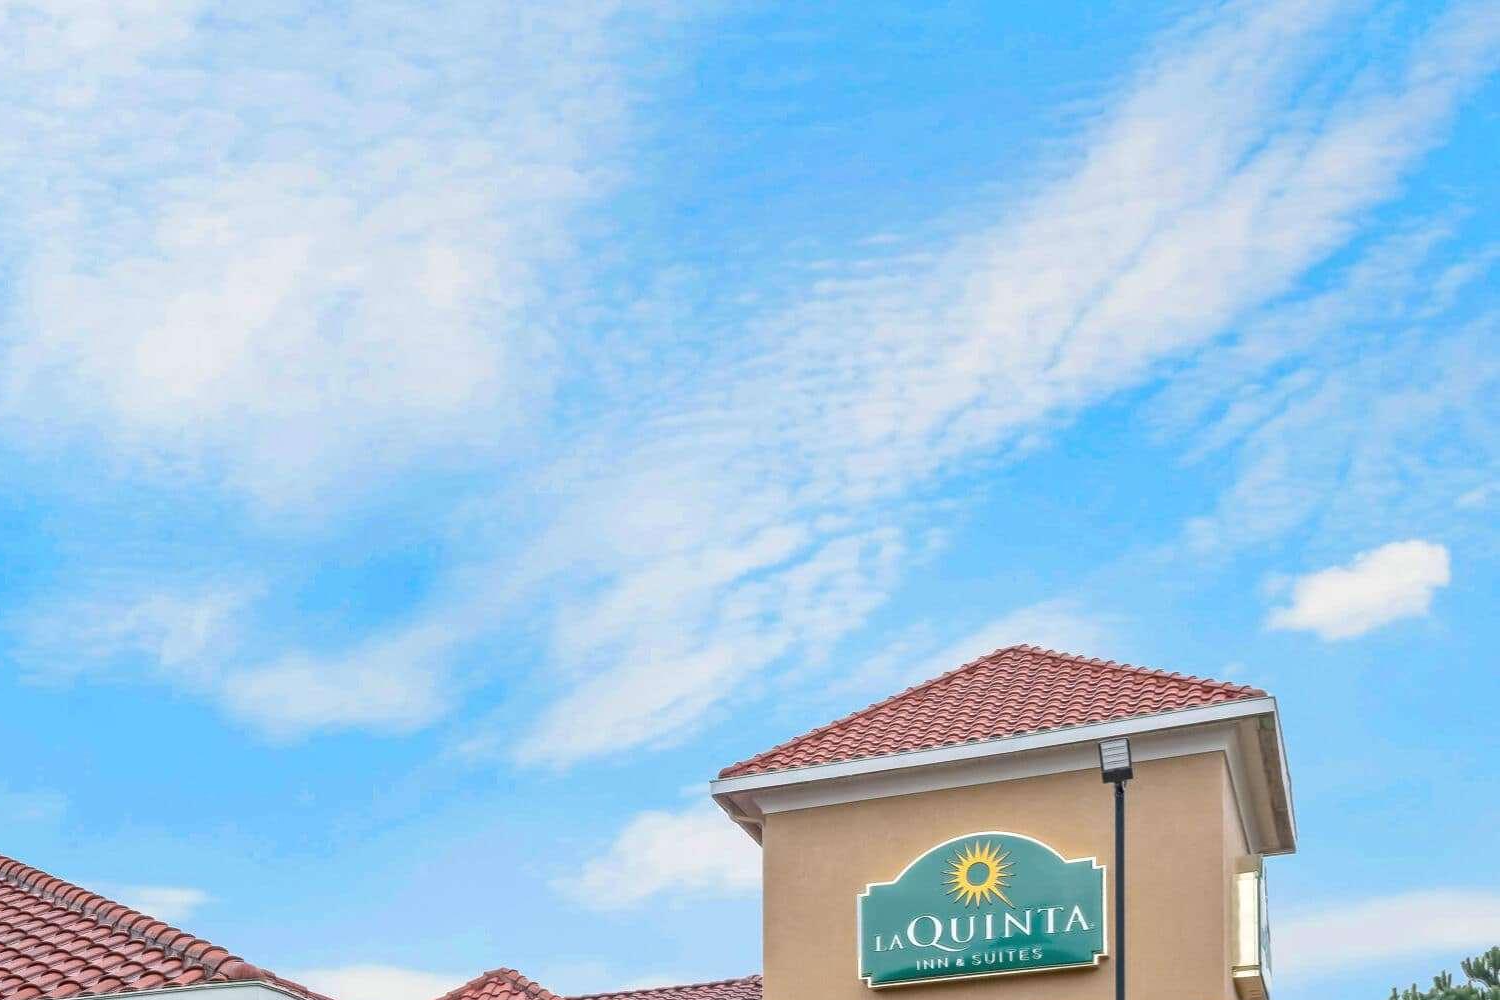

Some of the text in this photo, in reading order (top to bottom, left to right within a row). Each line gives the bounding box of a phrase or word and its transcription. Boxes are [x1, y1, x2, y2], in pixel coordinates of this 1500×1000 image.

[874, 904, 1090, 952] LA QUINTA
[916, 949, 1043, 970] INN & SUITES
